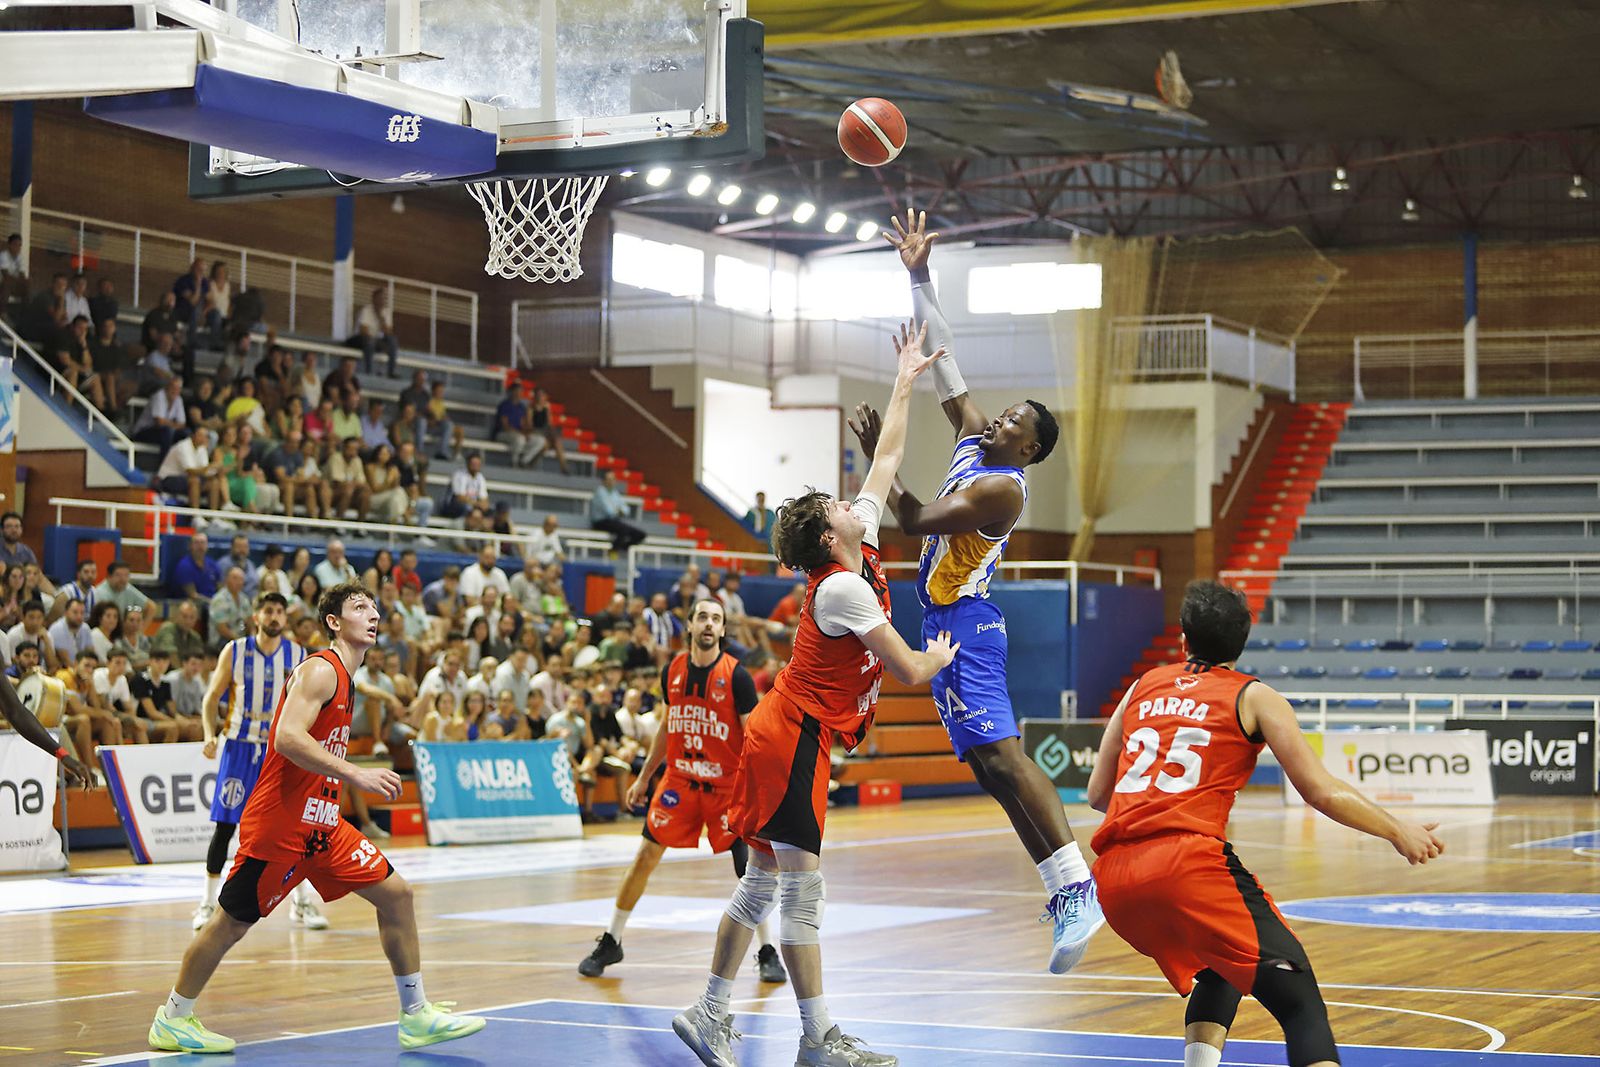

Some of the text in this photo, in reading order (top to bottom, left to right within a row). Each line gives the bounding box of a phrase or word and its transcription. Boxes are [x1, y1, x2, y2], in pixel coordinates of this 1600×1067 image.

[385, 114, 422, 142] GES
[1138, 697, 1210, 722] PARRA
[683, 735, 703, 750] 30
[1114, 727, 1212, 793] 25
[1343, 743, 1470, 782] ipema
[1529, 768, 1576, 785] original
[220, 779, 244, 809] MG
[351, 839, 377, 868] 28
